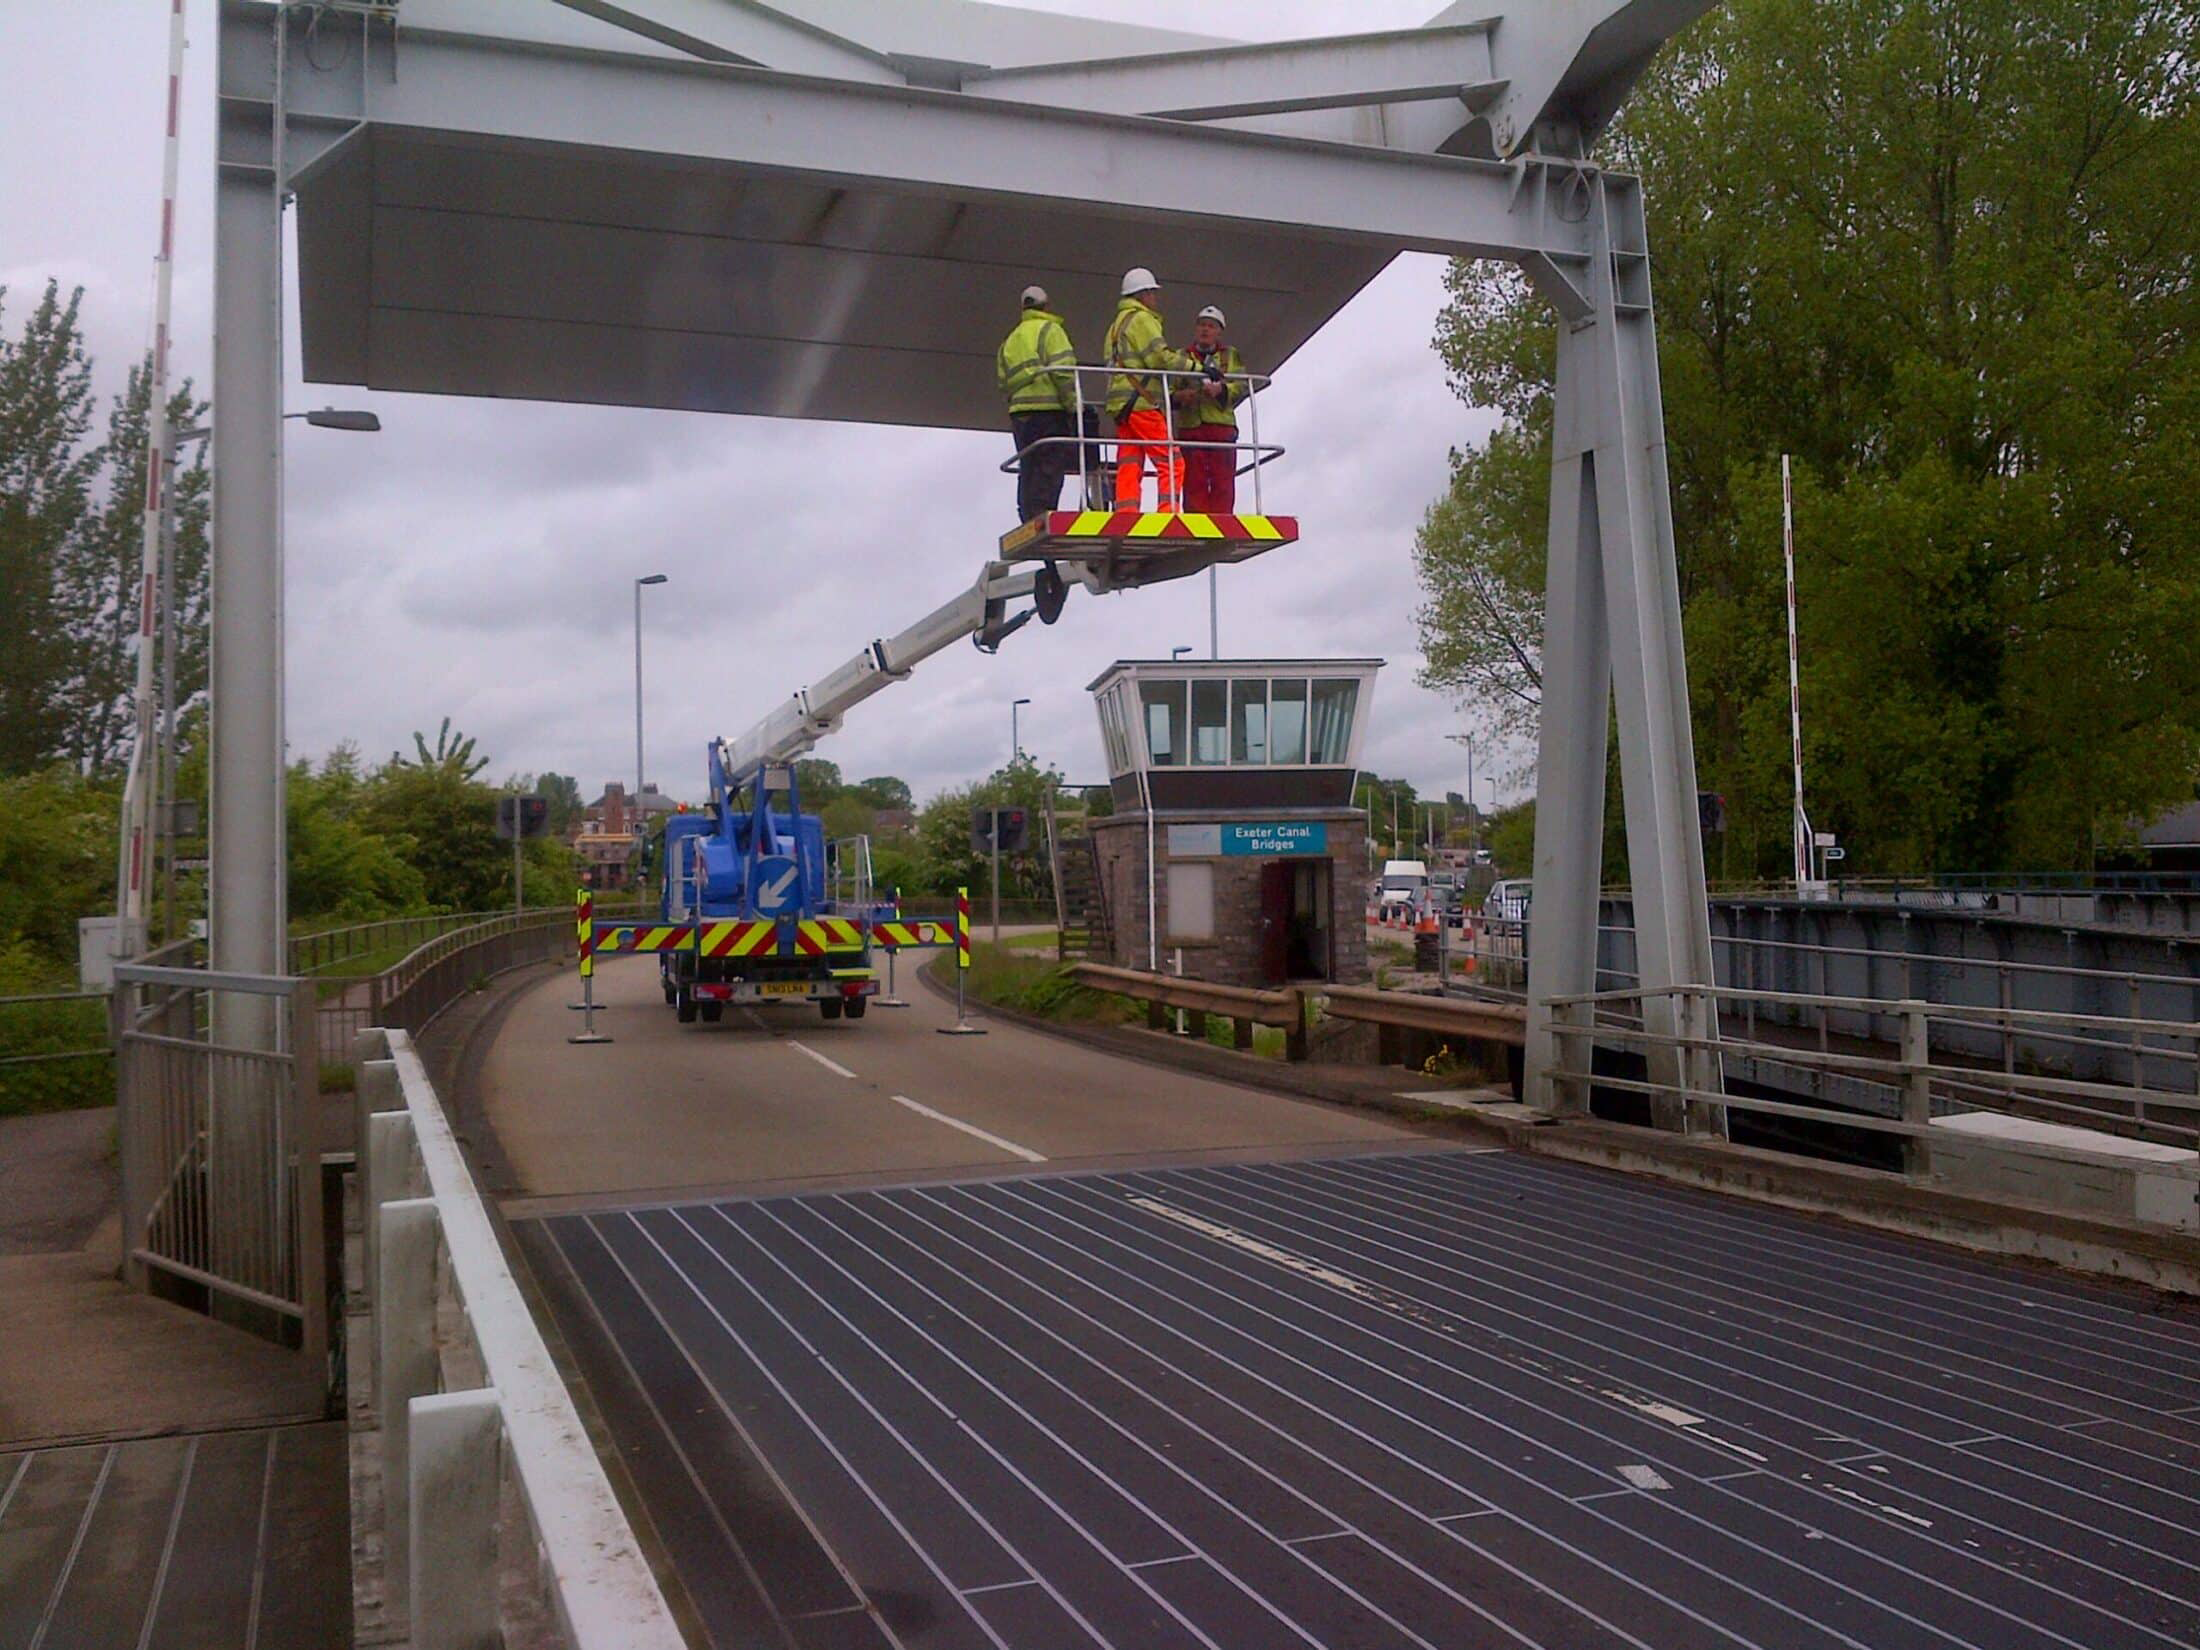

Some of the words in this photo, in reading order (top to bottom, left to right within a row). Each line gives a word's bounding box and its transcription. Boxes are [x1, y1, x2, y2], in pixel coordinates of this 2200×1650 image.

[1235, 827, 1272, 838] Exeter
[1277, 825, 1311, 837] Canal
[1251, 839, 1295, 851] Bridges
